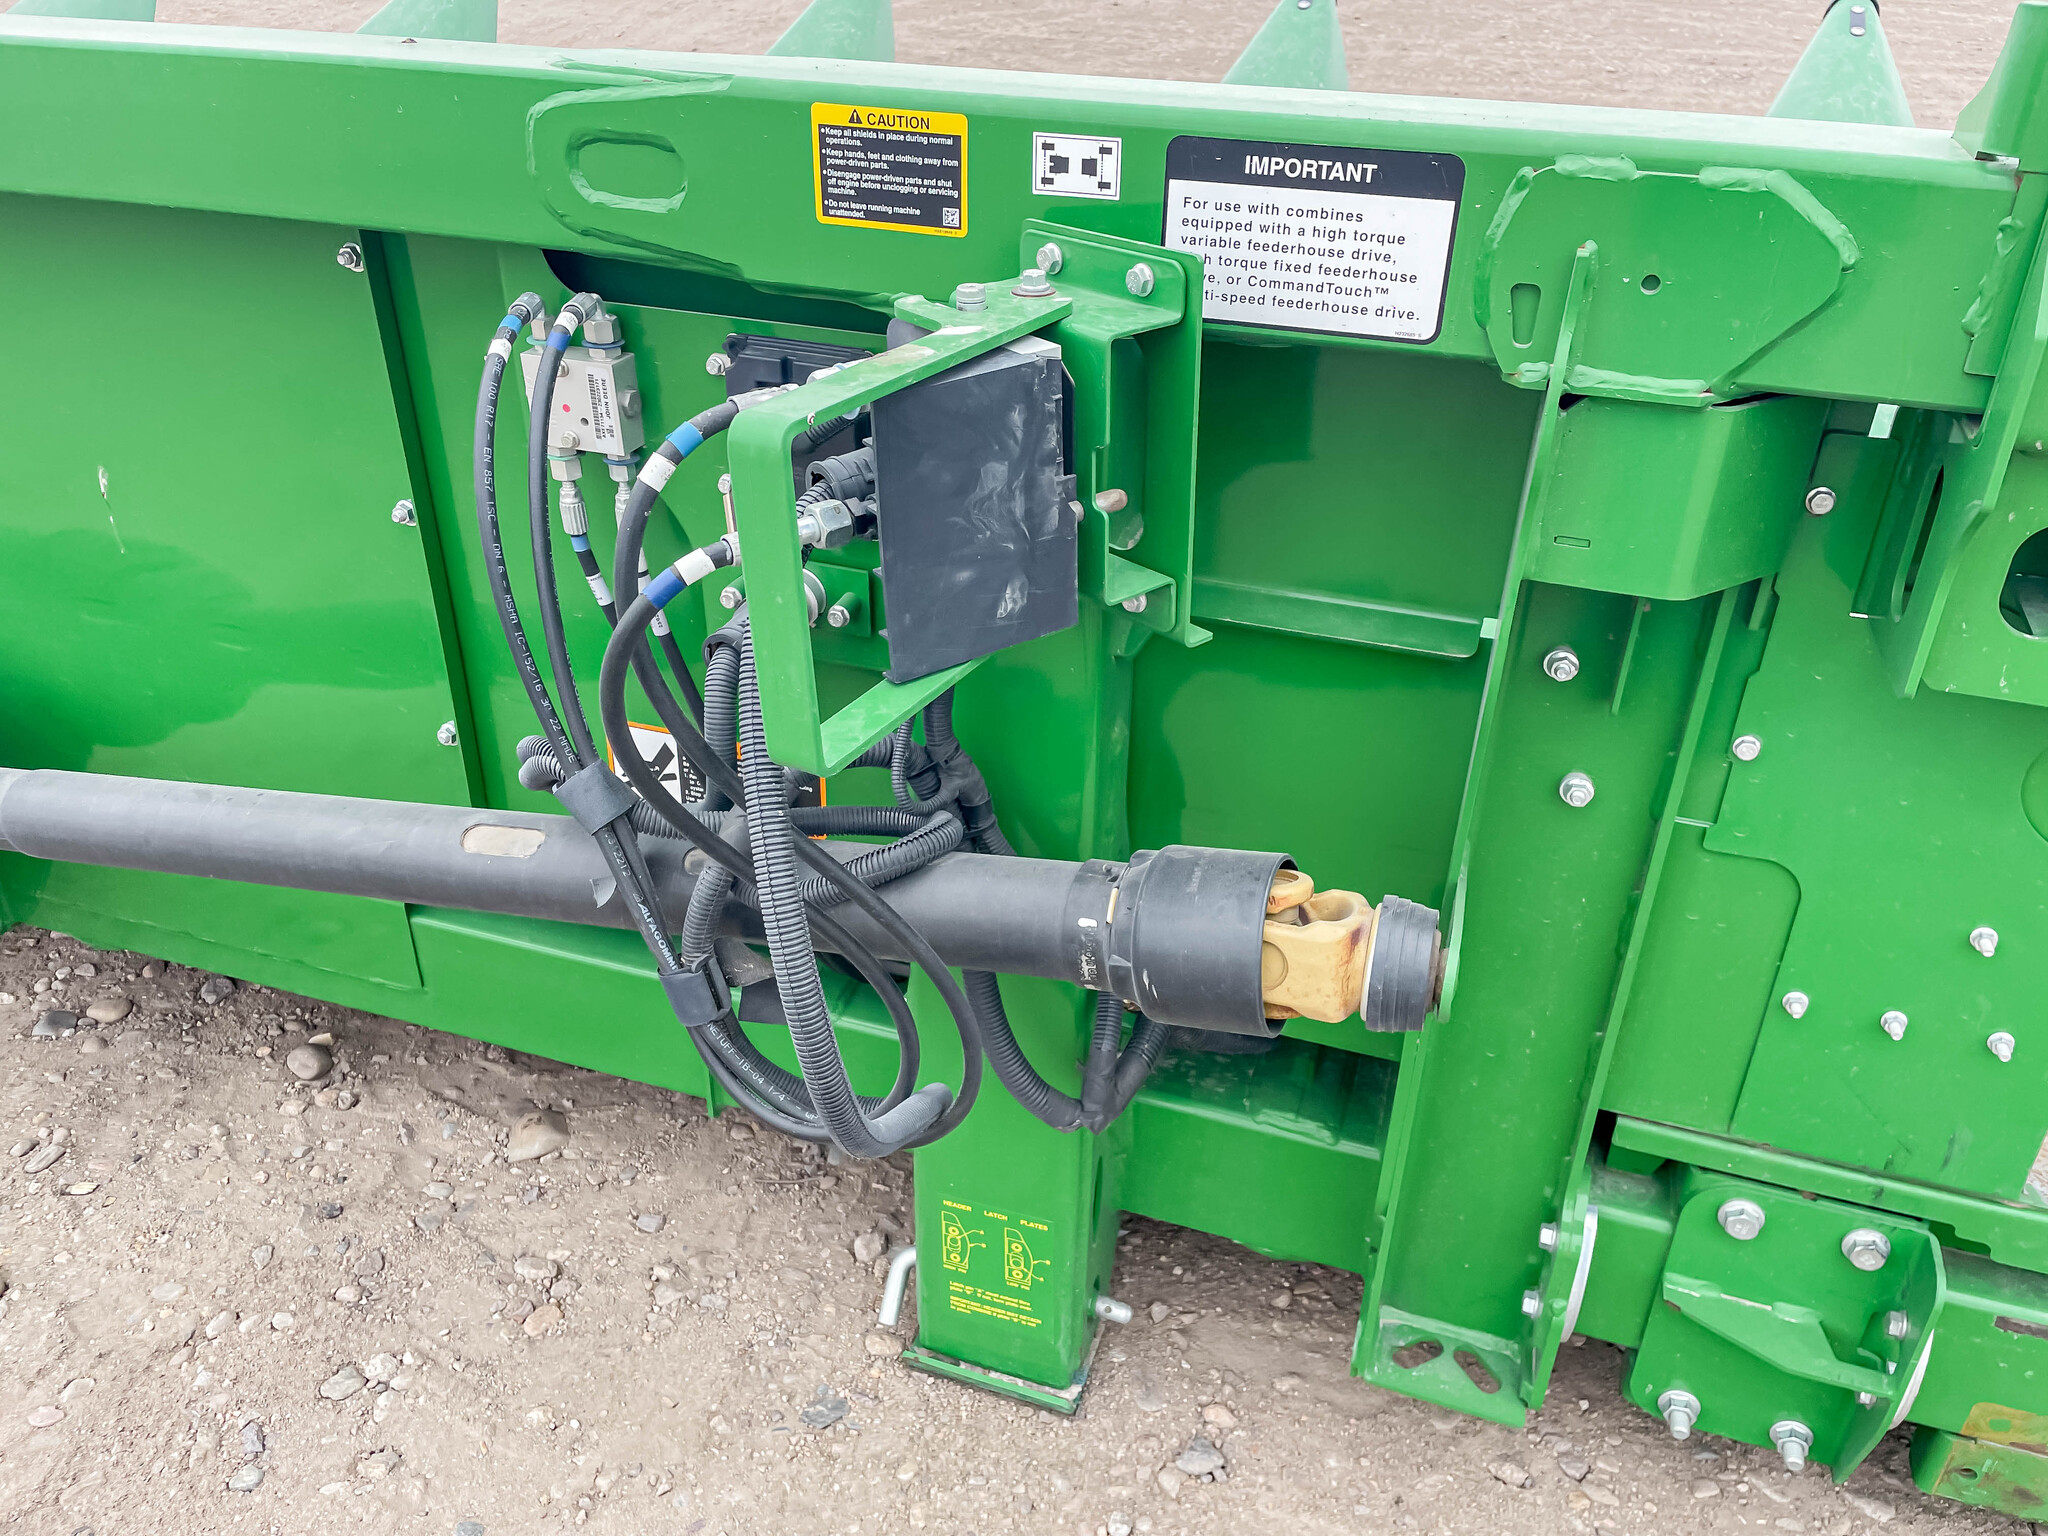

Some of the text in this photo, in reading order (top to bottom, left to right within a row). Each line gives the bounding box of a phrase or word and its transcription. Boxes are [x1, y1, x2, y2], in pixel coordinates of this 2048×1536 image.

[867, 113, 930, 129] CAUTION
[826, 128, 841, 136] Keep
[853, 131, 876, 139] shields
[886, 134, 904, 142] place
[906, 135, 928, 144] during
[929, 137, 953, 145] normal
[826, 138, 862, 146] operations.
[826, 148, 843, 157] Keep
[845, 150, 866, 159] hands,
[896, 154, 922, 165] clothing
[924, 158, 940, 166] away
[942, 158, 958, 167] from
[826, 158, 869, 169] power-driven
[828, 169, 860, 180] Disengage
[862, 173, 904, 183] power-driven
[905, 176, 922, 185] parts
[924, 177, 936, 185] and
[1244, 154, 1378, 184] IMPORTANT
[828, 187, 856, 195] machine.
[838, 180, 859, 188] engine
[861, 181, 881, 189] before
[882, 183, 918, 194] unclogging
[928, 188, 958, 198] servicing
[829, 209, 865, 218] unattended.
[868, 205, 892, 214] running
[894, 207, 920, 215] machine
[1184, 197, 1363, 222] For use with combines
[1182, 217, 1406, 246] equipped with a high torque
[1181, 234, 1397, 265] variable feederhouse drive,
[1218, 255, 1268, 270] torque
[1274, 259, 1311, 274] fixed
[1318, 263, 1418, 284] feederhouse
[1226, 276, 1242, 285] or
[1248, 276, 1389, 298] CommandTouch™
[1205, 290, 1420, 321] ti-speed feederhouse drive.
[492, 357, 503, 376] SAE
[487, 383, 497, 399] 100
[484, 406, 495, 429] R17
[483, 447, 492, 462] EN
[484, 469, 493, 492] 857
[492, 543, 502, 559] DN
[504, 594, 519, 625] MSHA
[515, 632, 543, 692] IC-152/16
[549, 719, 561, 731] 22
[558, 735, 576, 763] MADE
[943, 1200, 1048, 1231] HEADER LATCH PLATES
